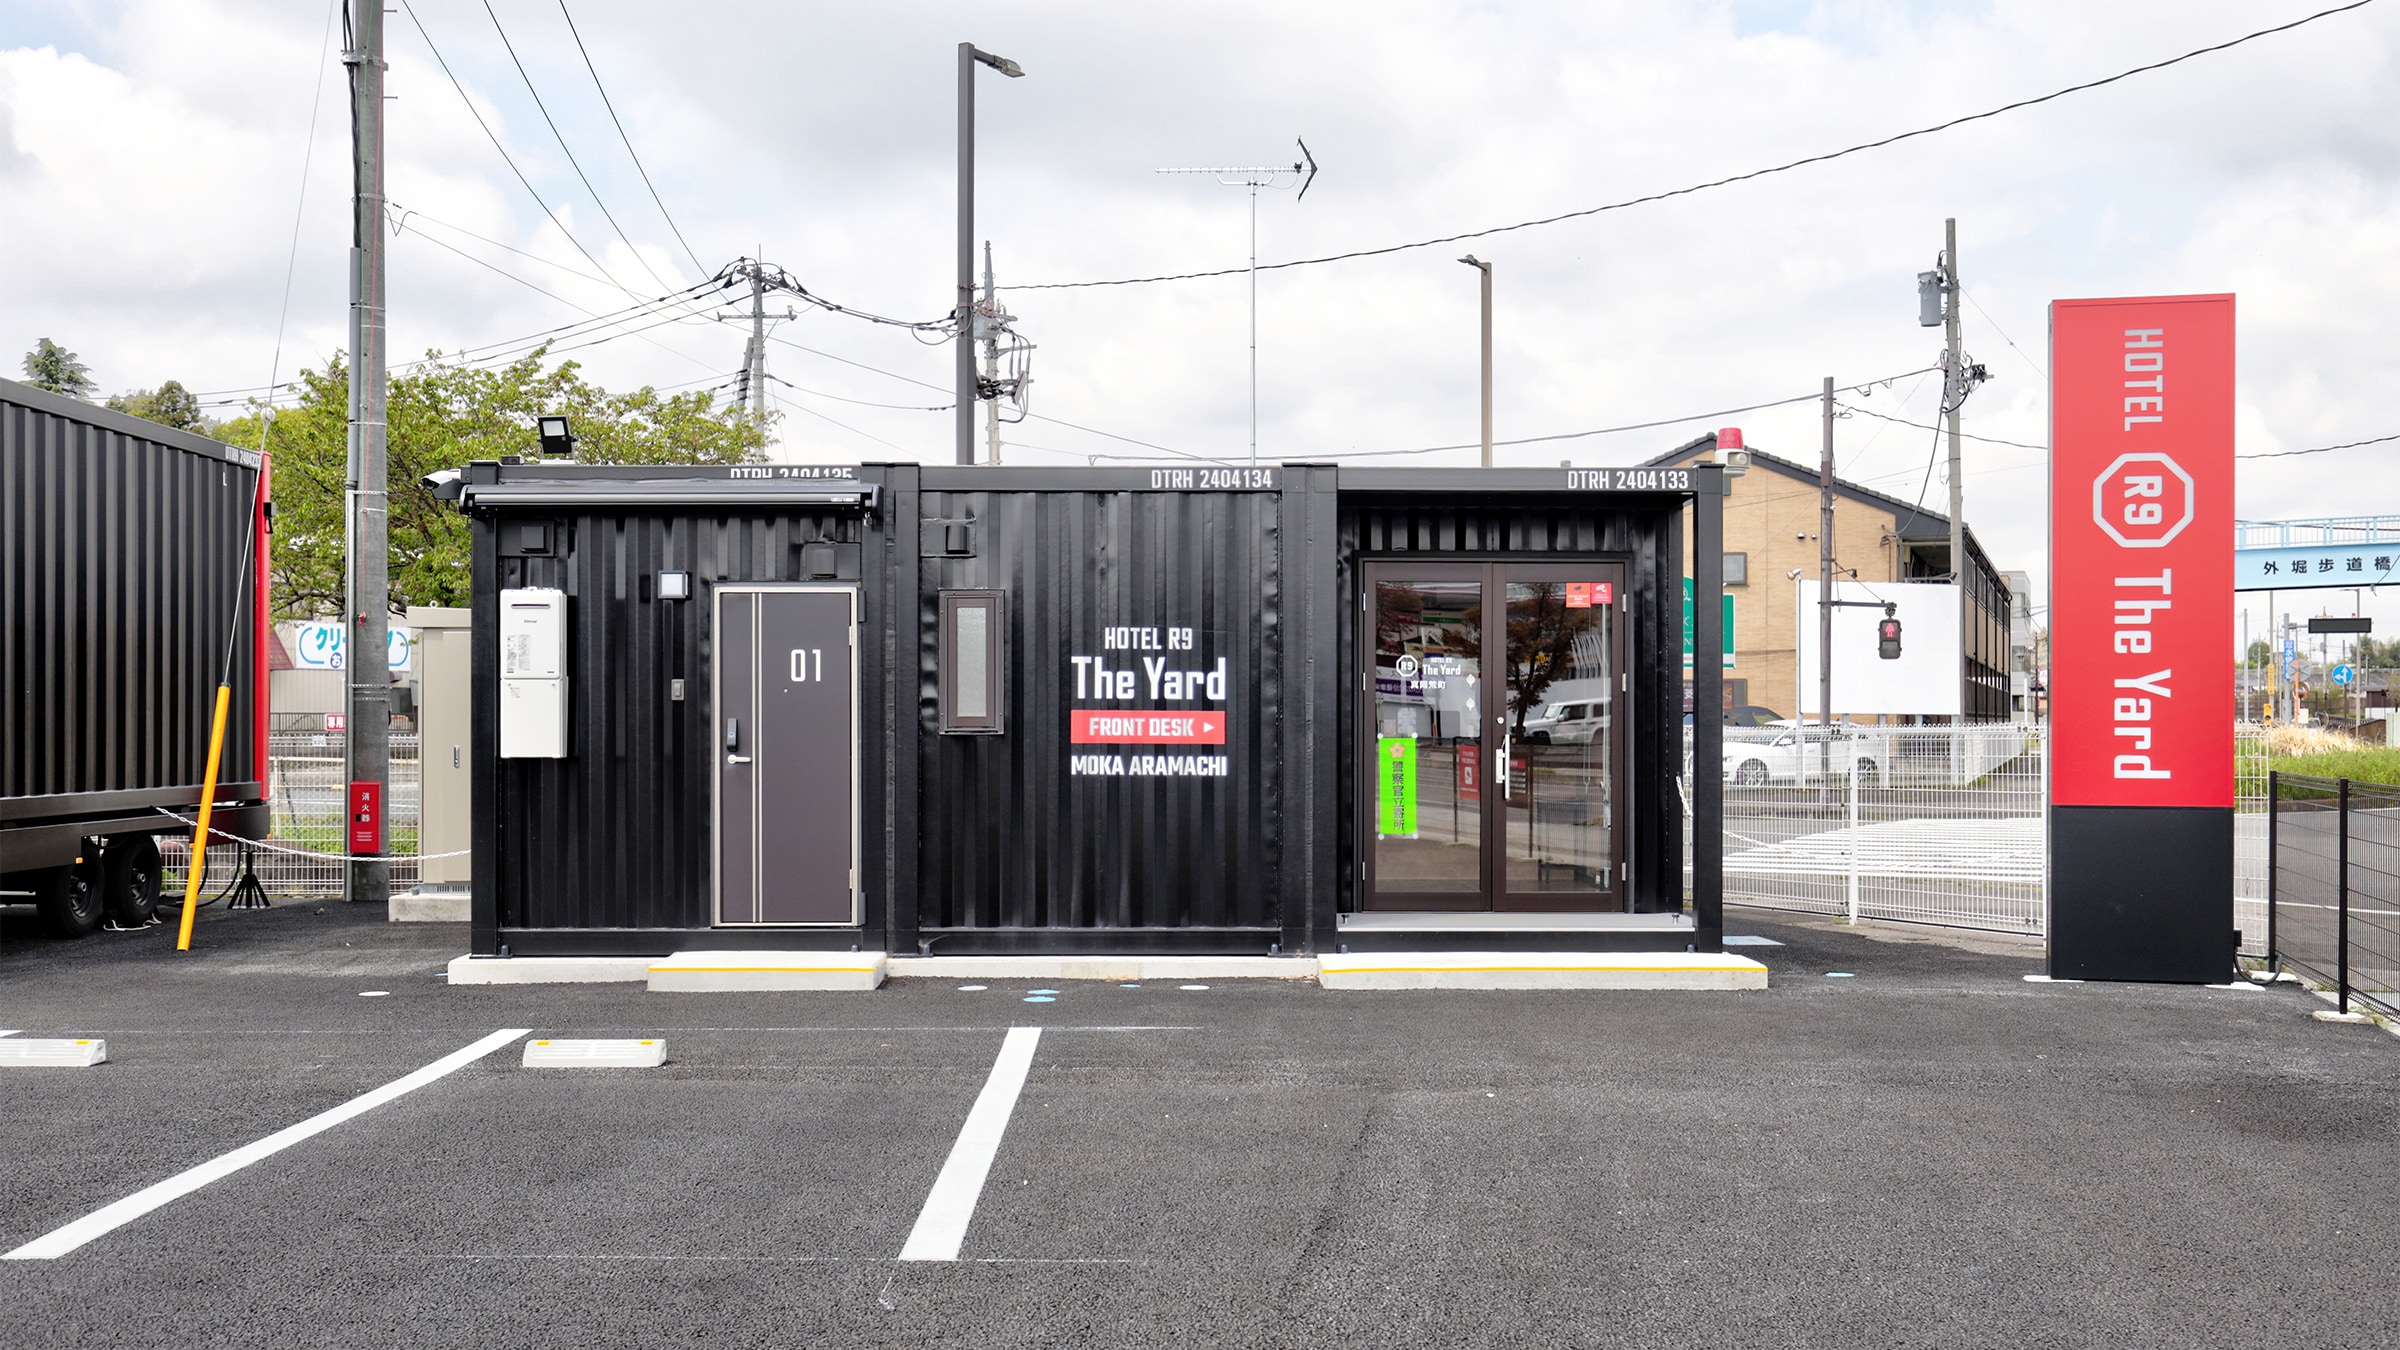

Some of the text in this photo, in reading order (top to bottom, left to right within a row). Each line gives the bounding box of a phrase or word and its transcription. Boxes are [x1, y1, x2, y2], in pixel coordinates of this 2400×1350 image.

[1151, 469, 1273, 489] DTRH 2404134
[1567, 470, 1689, 489] DTRH 2404133
[2114, 328, 2172, 779] HOTEL R9 The Yard
[2263, 556, 2391, 576] 外堀歩道橋
[1104, 627, 1193, 650] HOTEL R9
[790, 648, 821, 682] 01
[1400, 661, 1414, 671] R9
[1422, 664, 1438, 676] The
[1440, 664, 1461, 676] Yard
[1070, 655, 1226, 701] The Yard
[1089, 717, 1195, 737] FRONT DESK
[1071, 755, 1228, 777] MOKA ARAMACHI
